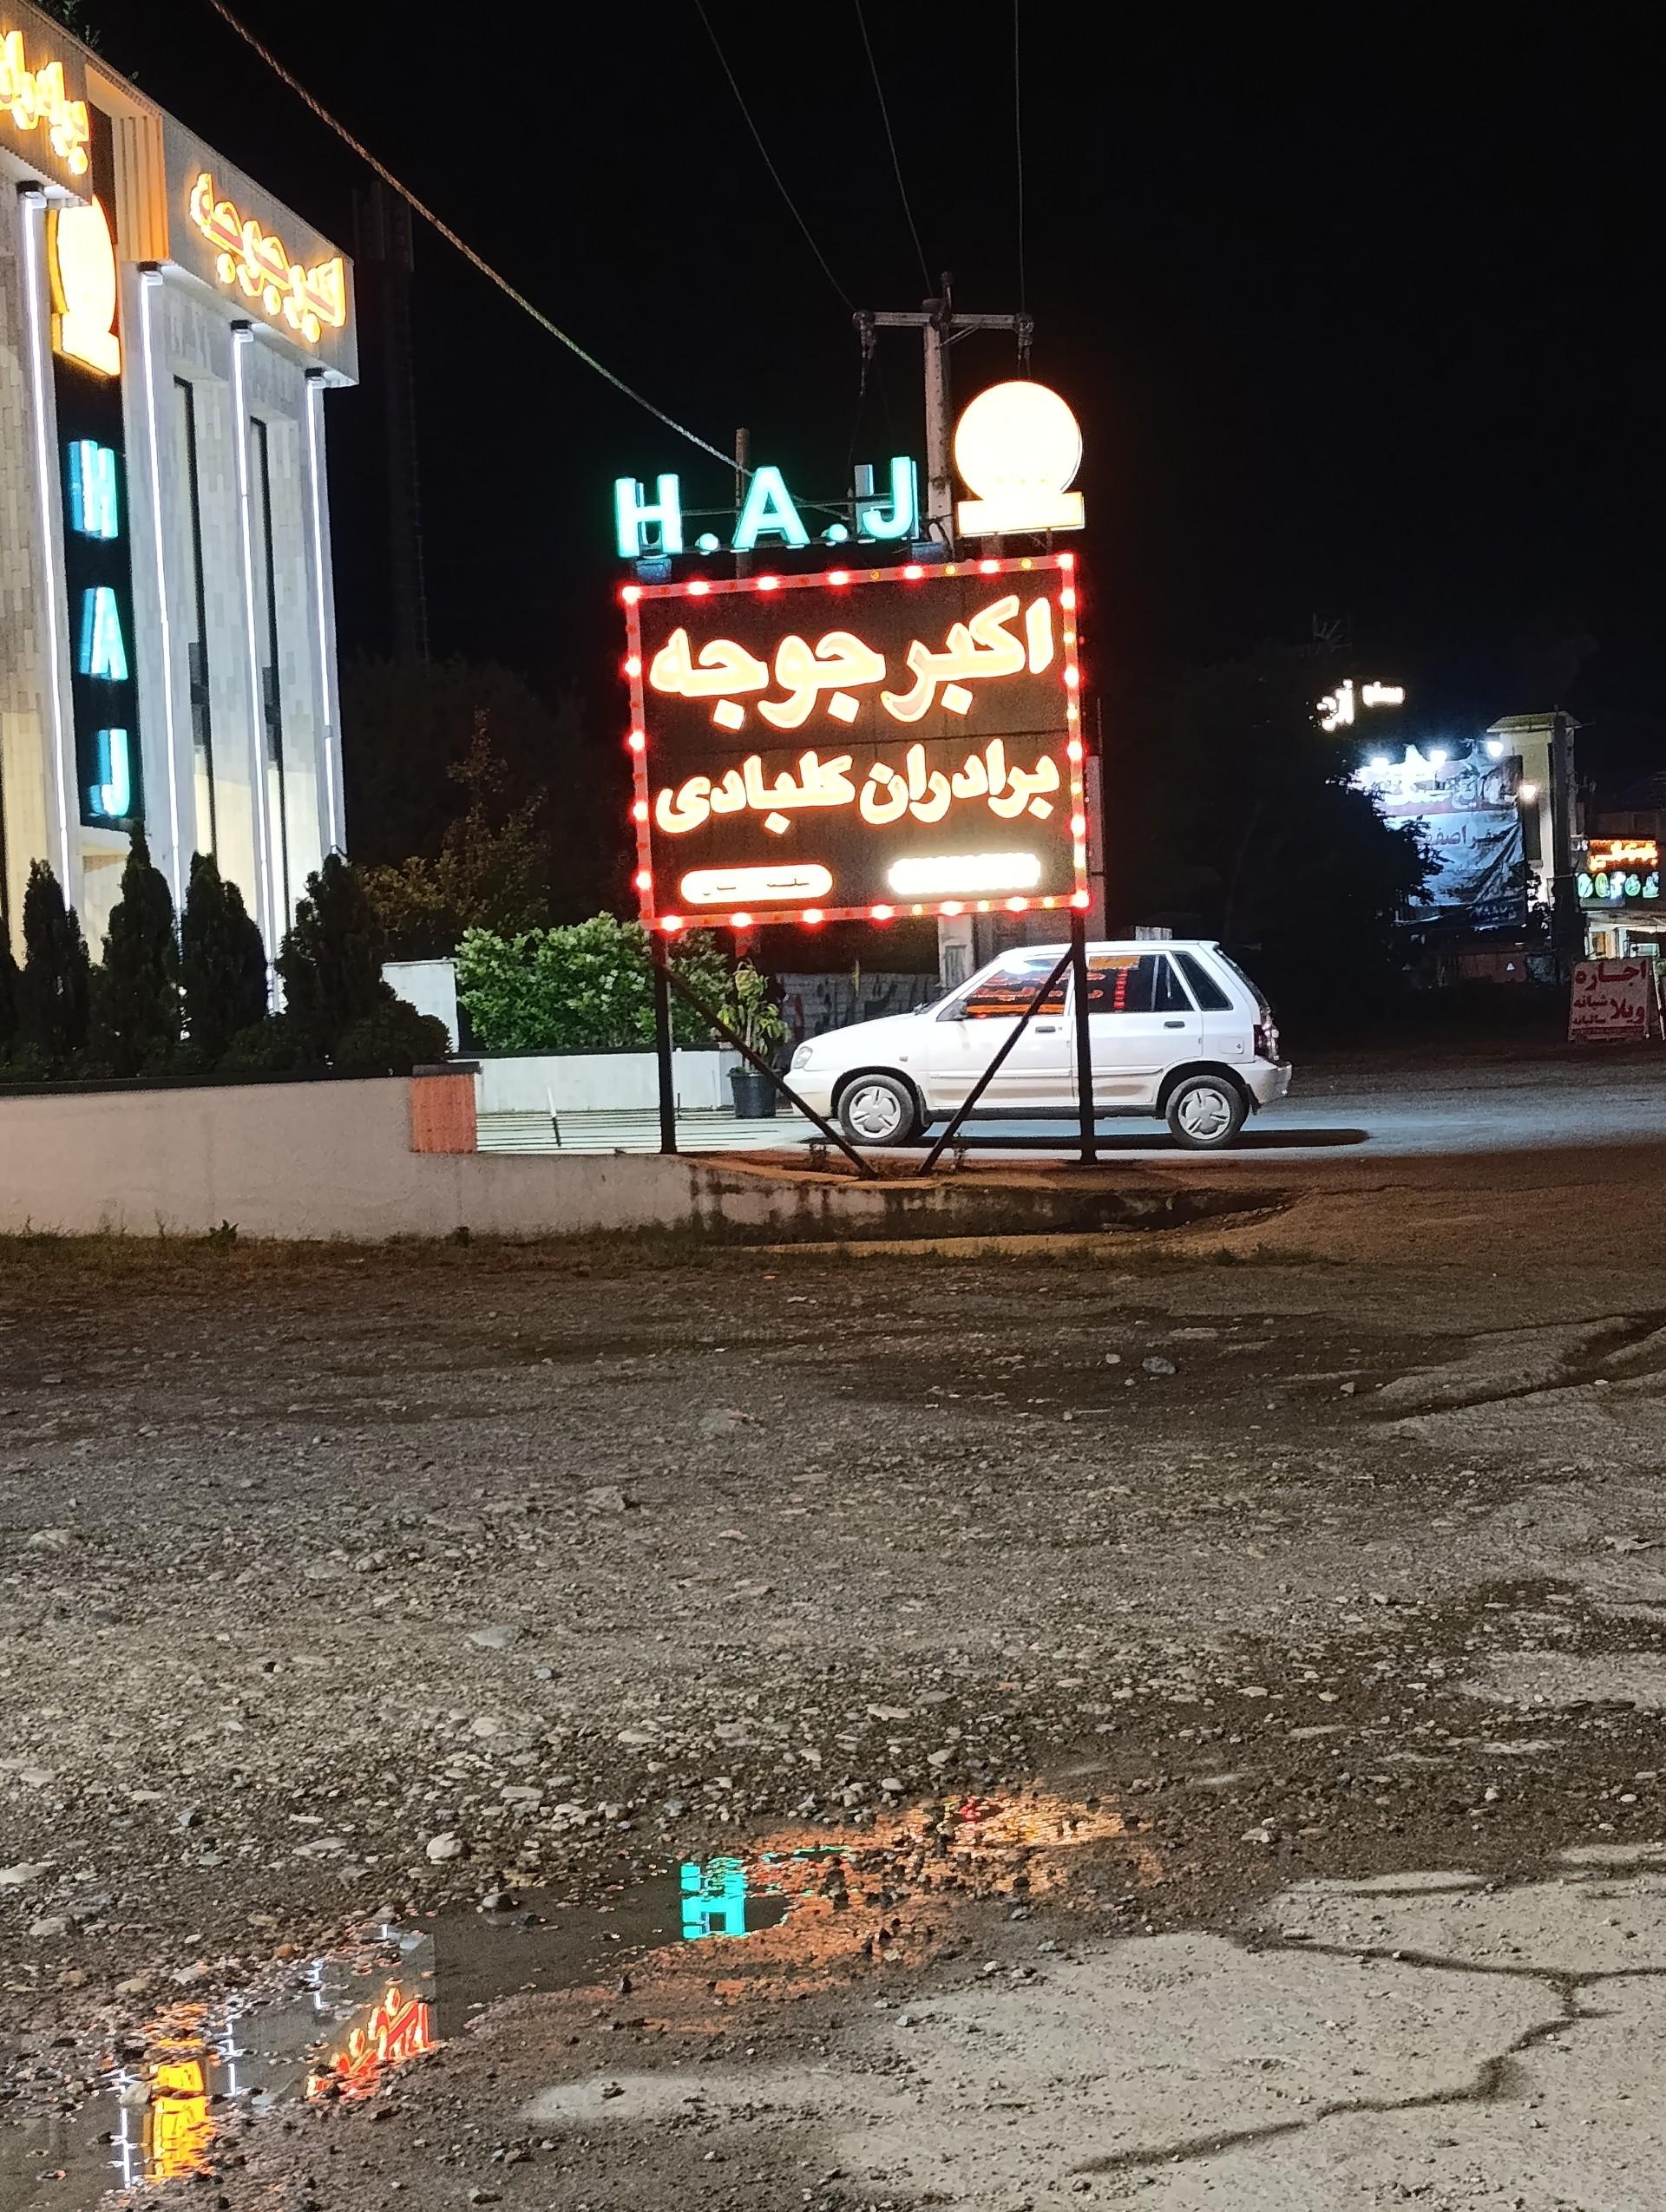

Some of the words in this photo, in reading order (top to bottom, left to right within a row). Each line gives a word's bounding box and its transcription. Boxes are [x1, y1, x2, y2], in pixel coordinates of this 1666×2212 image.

[190, 173, 291, 315] جوجه
[283, 257, 346, 344] اکبر
[649, 625, 887, 730] جوجه
[880, 593, 1055, 723] اکبر
[858, 737, 1061, 826] برادران
[1575, 959, 1647, 991] اجاره
[1610, 998, 1645, 1024] ویلا
